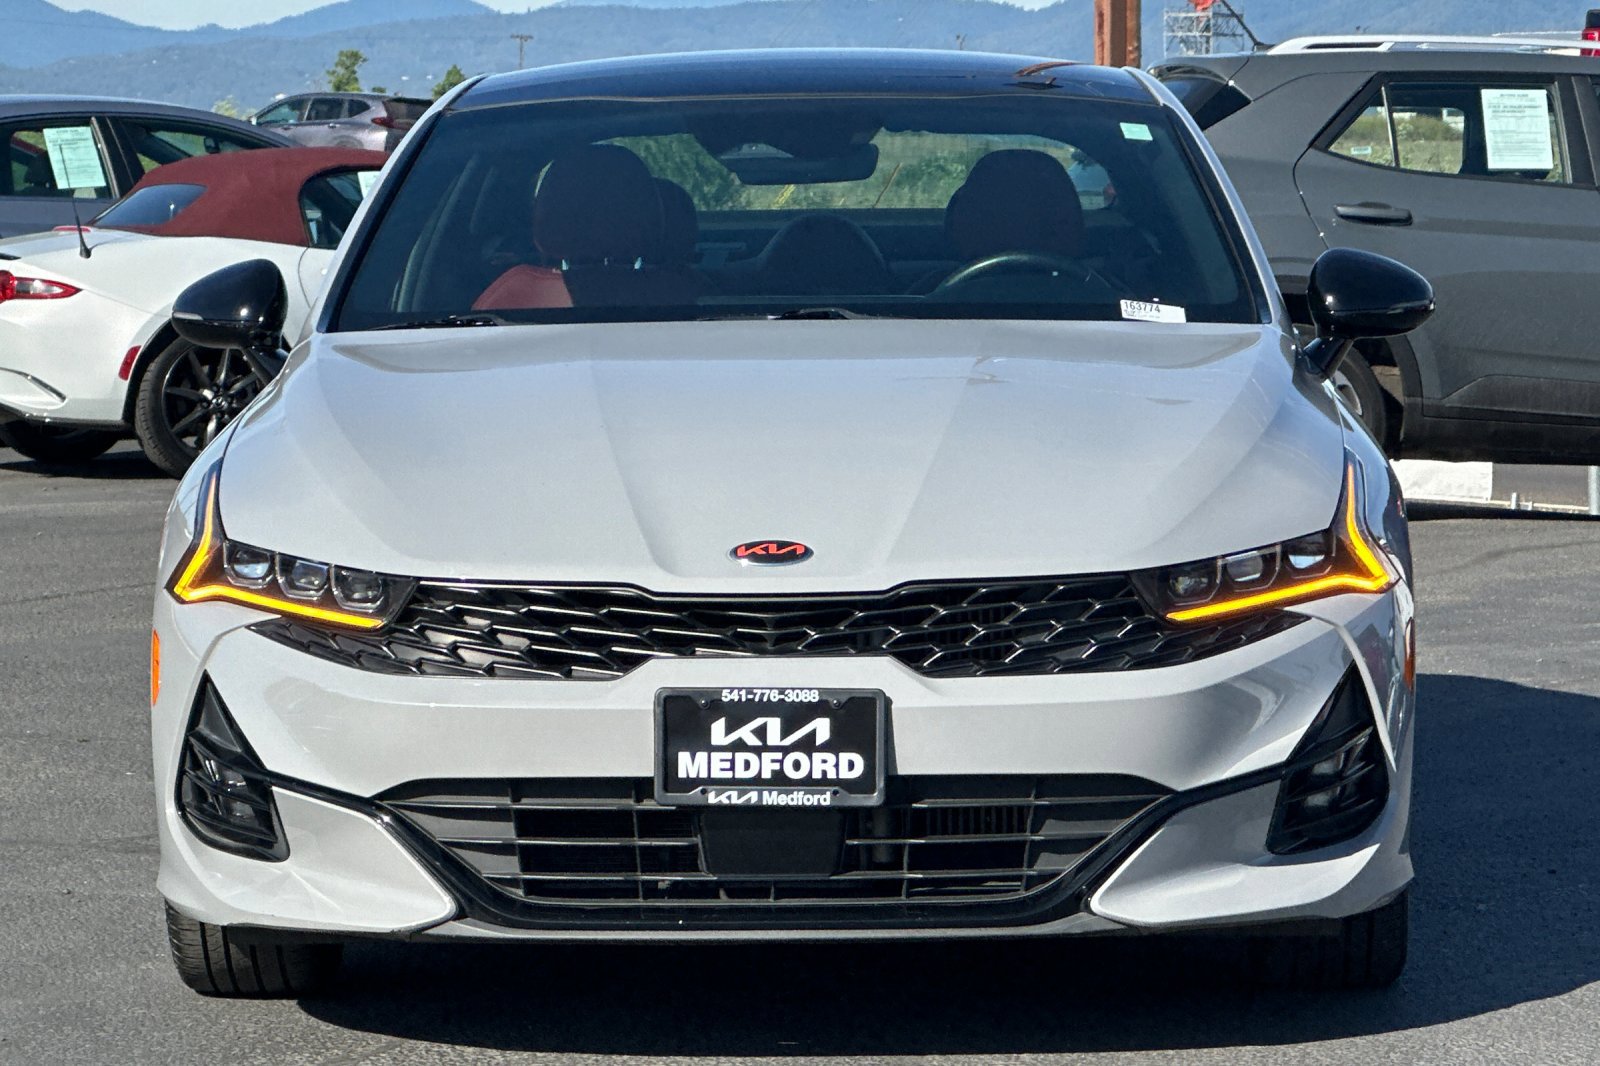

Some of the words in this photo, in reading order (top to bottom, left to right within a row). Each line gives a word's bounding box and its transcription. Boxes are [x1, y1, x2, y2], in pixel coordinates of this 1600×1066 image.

[1124, 301, 1161, 313] 163774
[736, 543, 805, 557] KIA
[721, 688, 820, 703] 541-776-3088
[710, 716, 831, 746] KIA
[677, 751, 865, 780] MEDFORD
[707, 790, 758, 805] KIA
[762, 790, 832, 806] Medford
